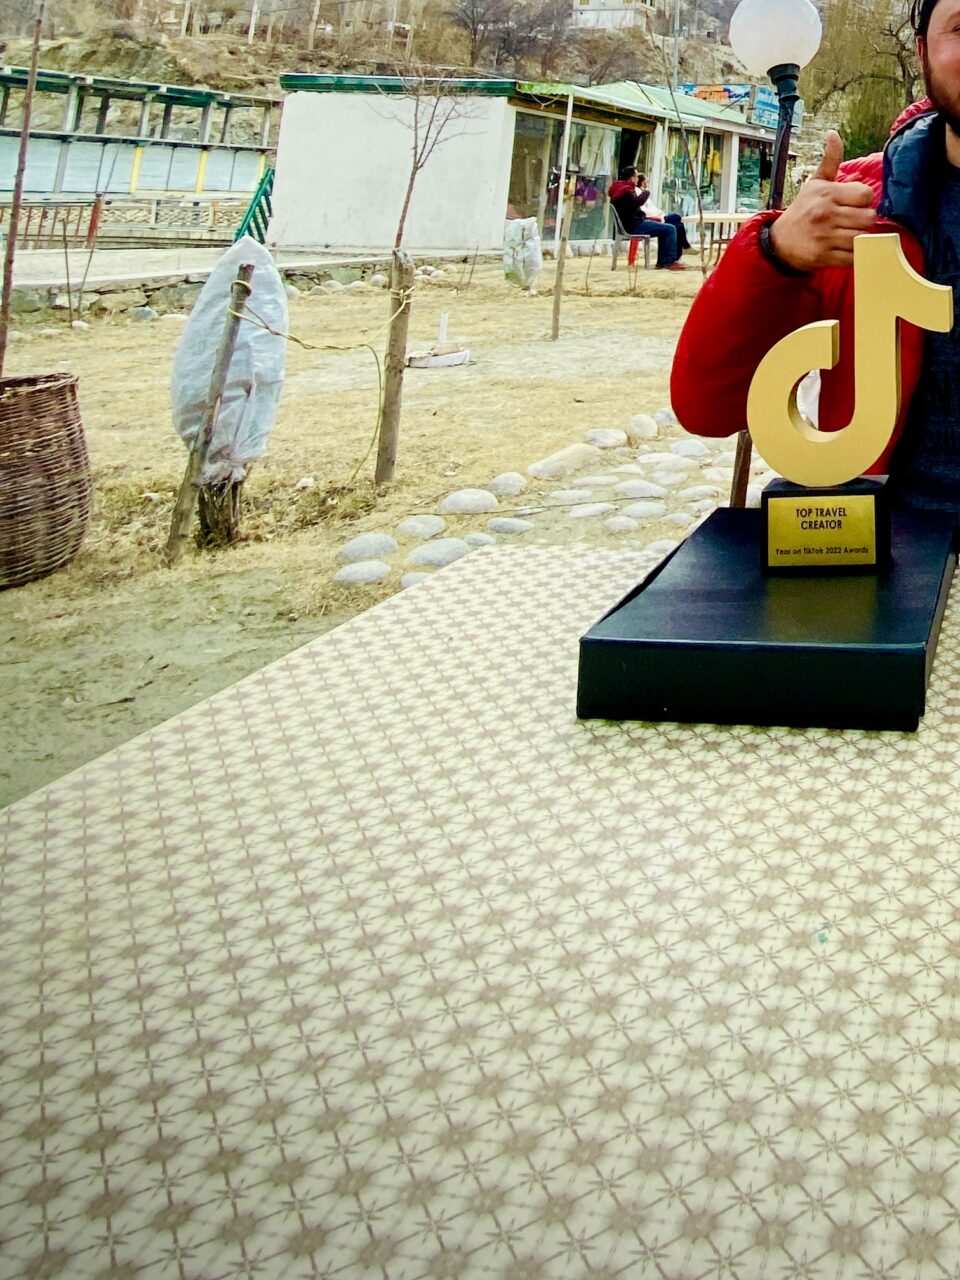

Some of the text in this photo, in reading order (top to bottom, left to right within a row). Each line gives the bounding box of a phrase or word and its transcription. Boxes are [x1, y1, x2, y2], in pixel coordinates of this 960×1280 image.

[796, 507, 847, 518] TOP TRAVEL
[801, 520, 842, 530] CREATOR
[826, 546, 841, 554] 2022
